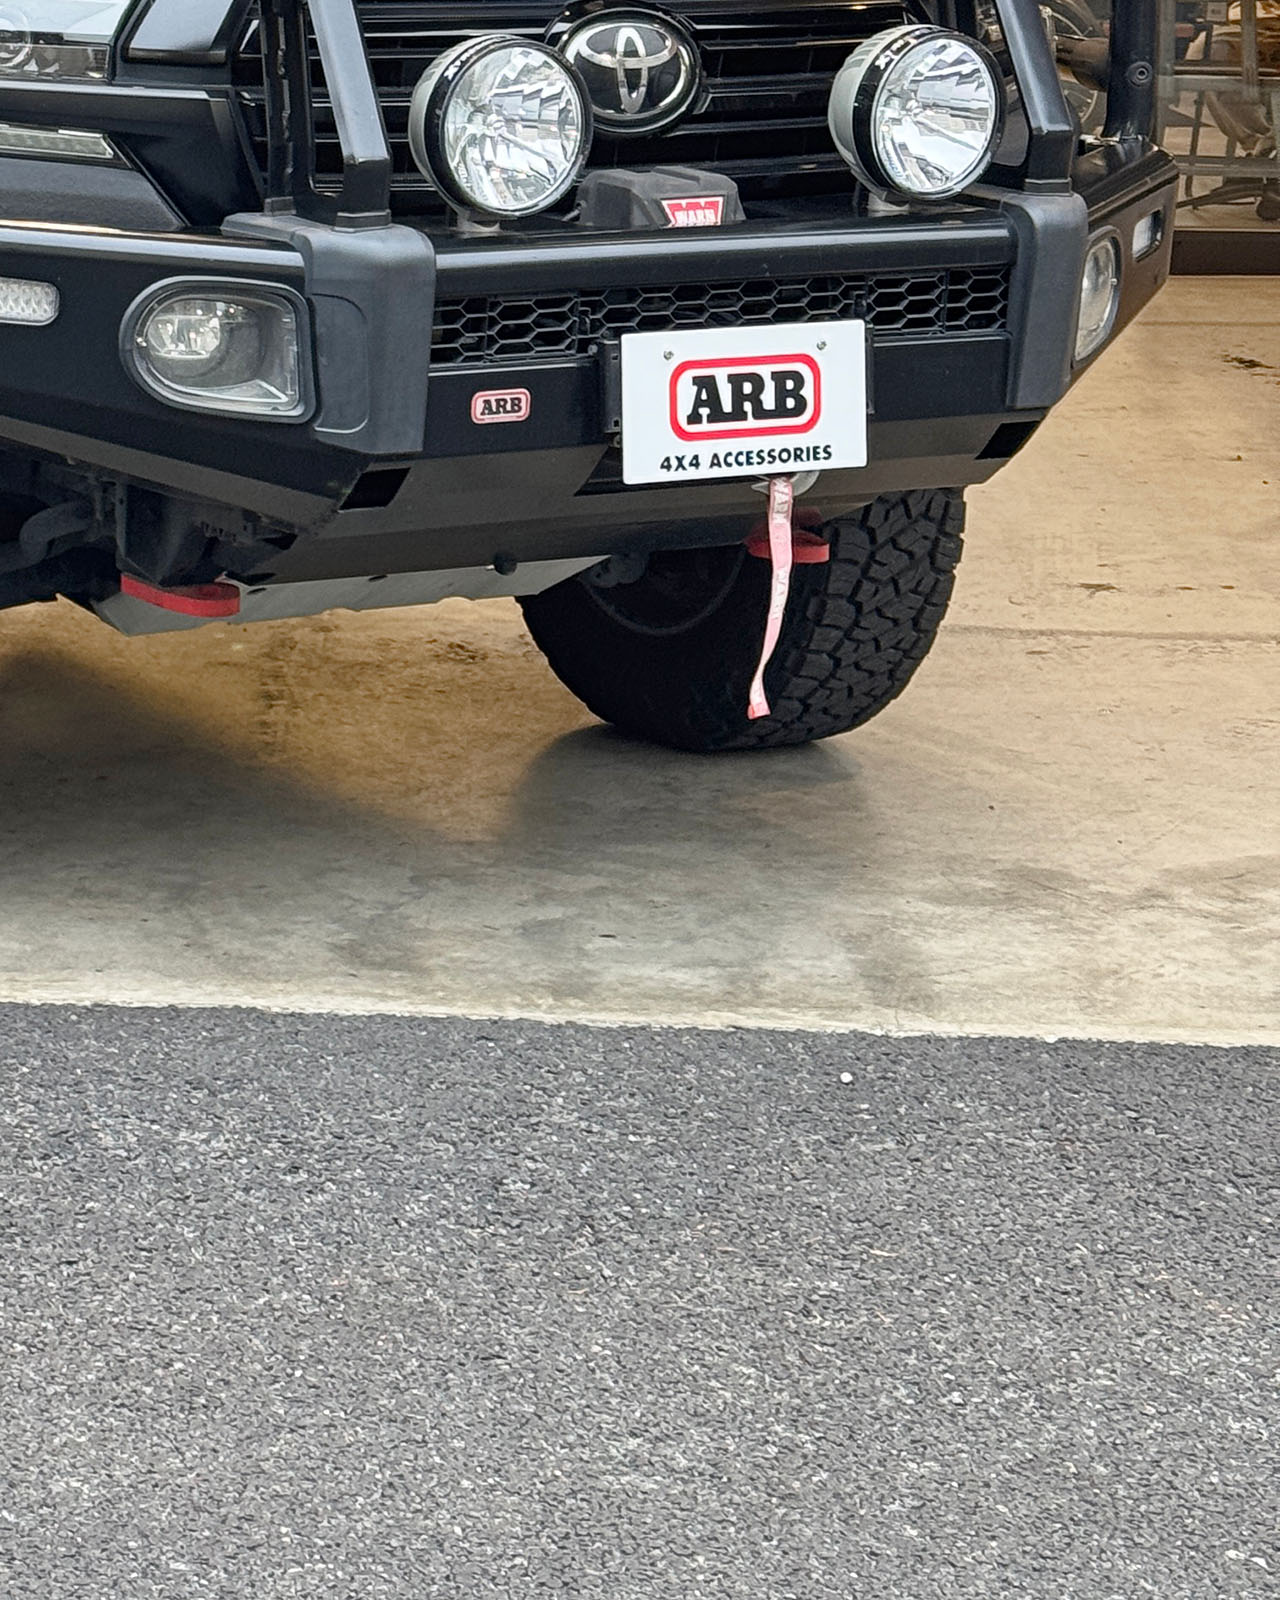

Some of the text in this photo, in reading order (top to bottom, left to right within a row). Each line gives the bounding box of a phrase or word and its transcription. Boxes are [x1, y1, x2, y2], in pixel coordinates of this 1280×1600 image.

[673, 208, 716, 225] WARN
[480, 396, 523, 416] ARB
[686, 370, 807, 425] ARB
[659, 444, 833, 473] 4X4 ACCESSORIES
